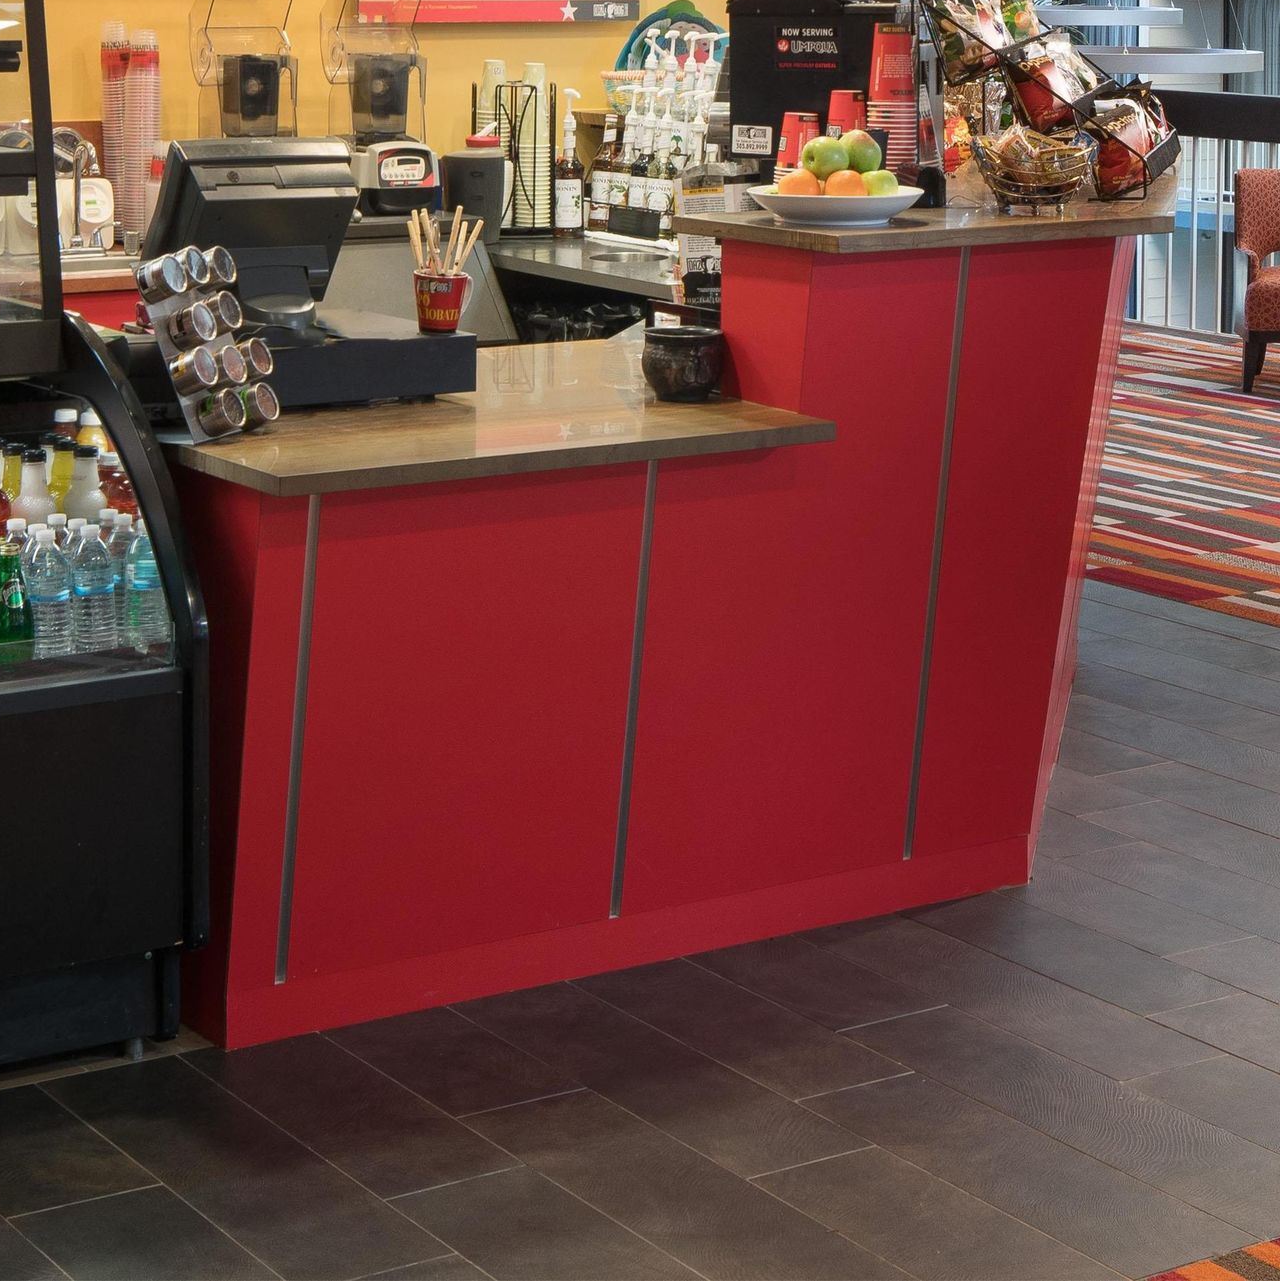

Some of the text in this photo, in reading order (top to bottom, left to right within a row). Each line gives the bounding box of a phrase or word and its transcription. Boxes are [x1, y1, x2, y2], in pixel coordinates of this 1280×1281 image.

[782, 28, 833, 36] NOW SERVING
[791, 41, 838, 53] UMPQUA
[688, 258, 702, 271] DAZ
